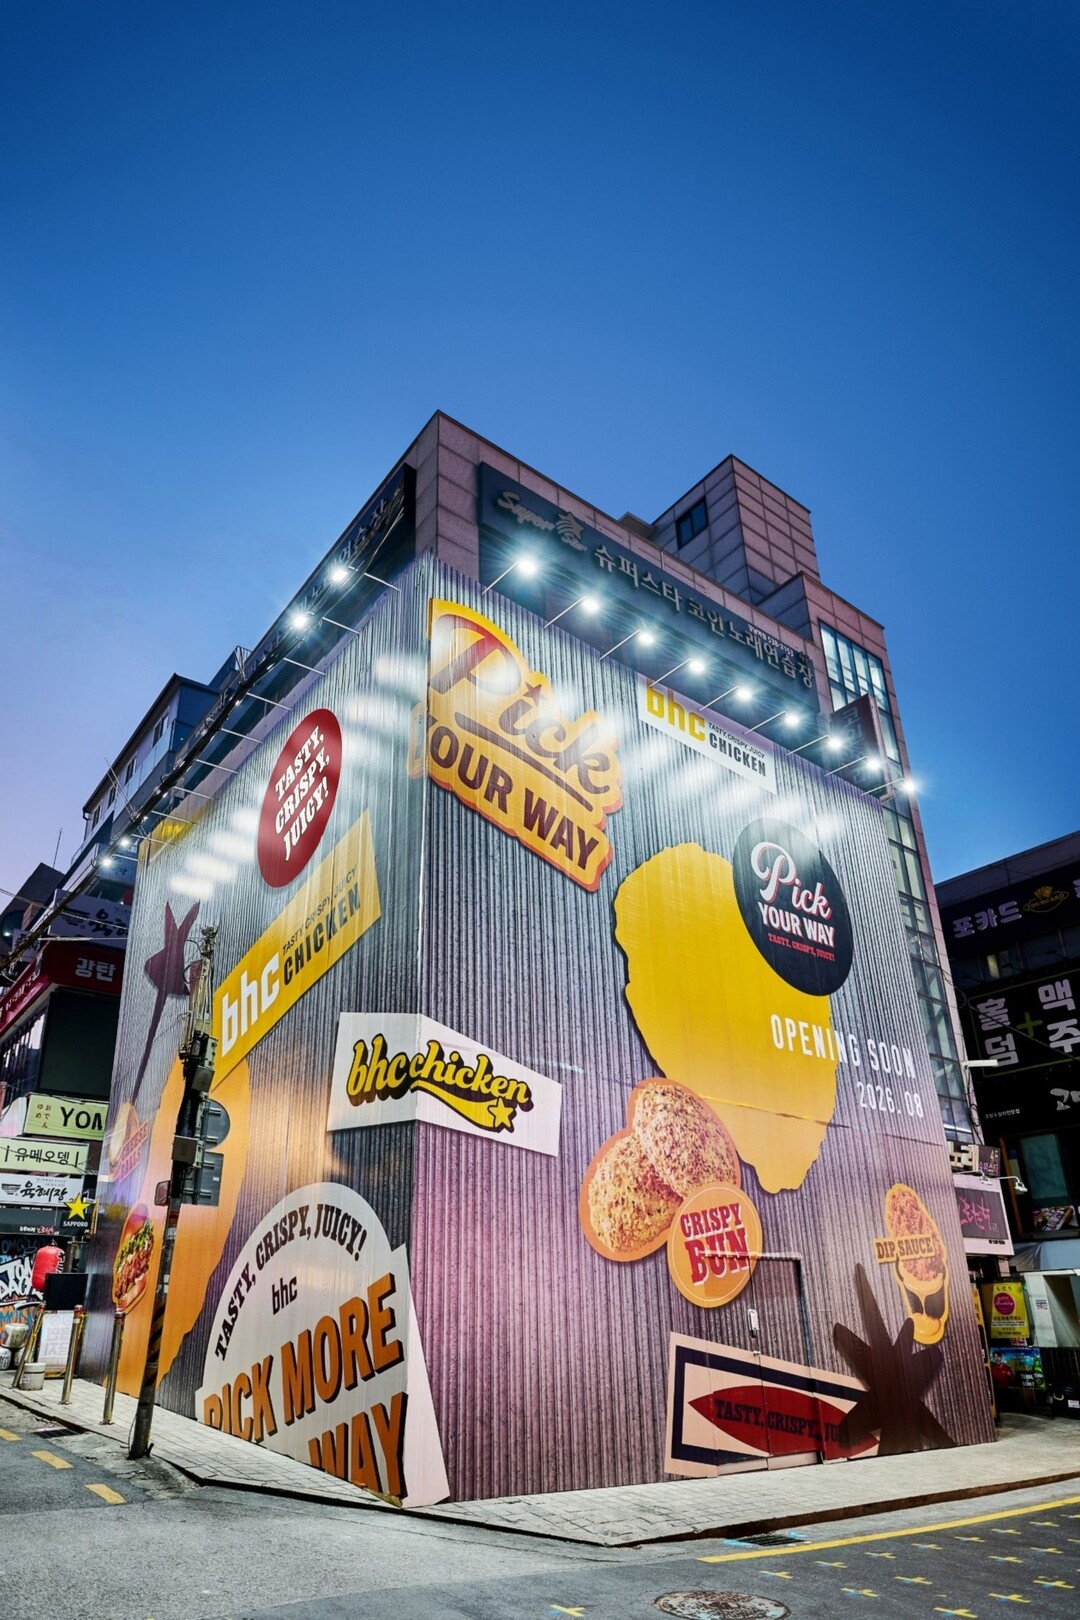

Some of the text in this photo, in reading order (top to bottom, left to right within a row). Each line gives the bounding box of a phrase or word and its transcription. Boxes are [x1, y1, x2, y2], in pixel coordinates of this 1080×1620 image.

[595, 545, 814, 689] 슈퍼스타 코인 노래연습장
[646, 678, 706, 742] bhc
[274, 725, 325, 801] TASTY,
[709, 732, 767, 777] CHICKEN
[274, 747, 330, 835] CRISPY,
[283, 776, 329, 861] JUICY!
[522, 787, 599, 870] WAY
[750, 841, 832, 921] Pick
[283, 882, 361, 986] CHICKEN
[757, 901, 836, 948] YOUR WAY
[952, 900, 1022, 939] 포카드
[221, 952, 280, 1057] bhc
[976, 997, 1019, 1068] 홀덤
[1037, 978, 1080, 1054] 맥주
[770, 1013, 917, 1079] OPENING SOON
[35, 1103, 43, 1118] ゆめ
[41, 1104, 52, 1129] おでん
[15, 1147, 70, 1166] 유메오뎅
[63, 1220, 89, 1228] SAPPORO
[680, 1202, 744, 1239] CRISPY
[875, 1236, 933, 1260] DIP SAUCE
[215, 1204, 367, 1361] TASTY, CRISPY, JUICY!
[684, 1229, 750, 1287] BUN
[271, 1276, 298, 1315] bhc
[203, 1272, 405, 1445] PICK MORE
[308, 1392, 409, 1499] WAY
[714, 1397, 765, 1428] TASTY,
